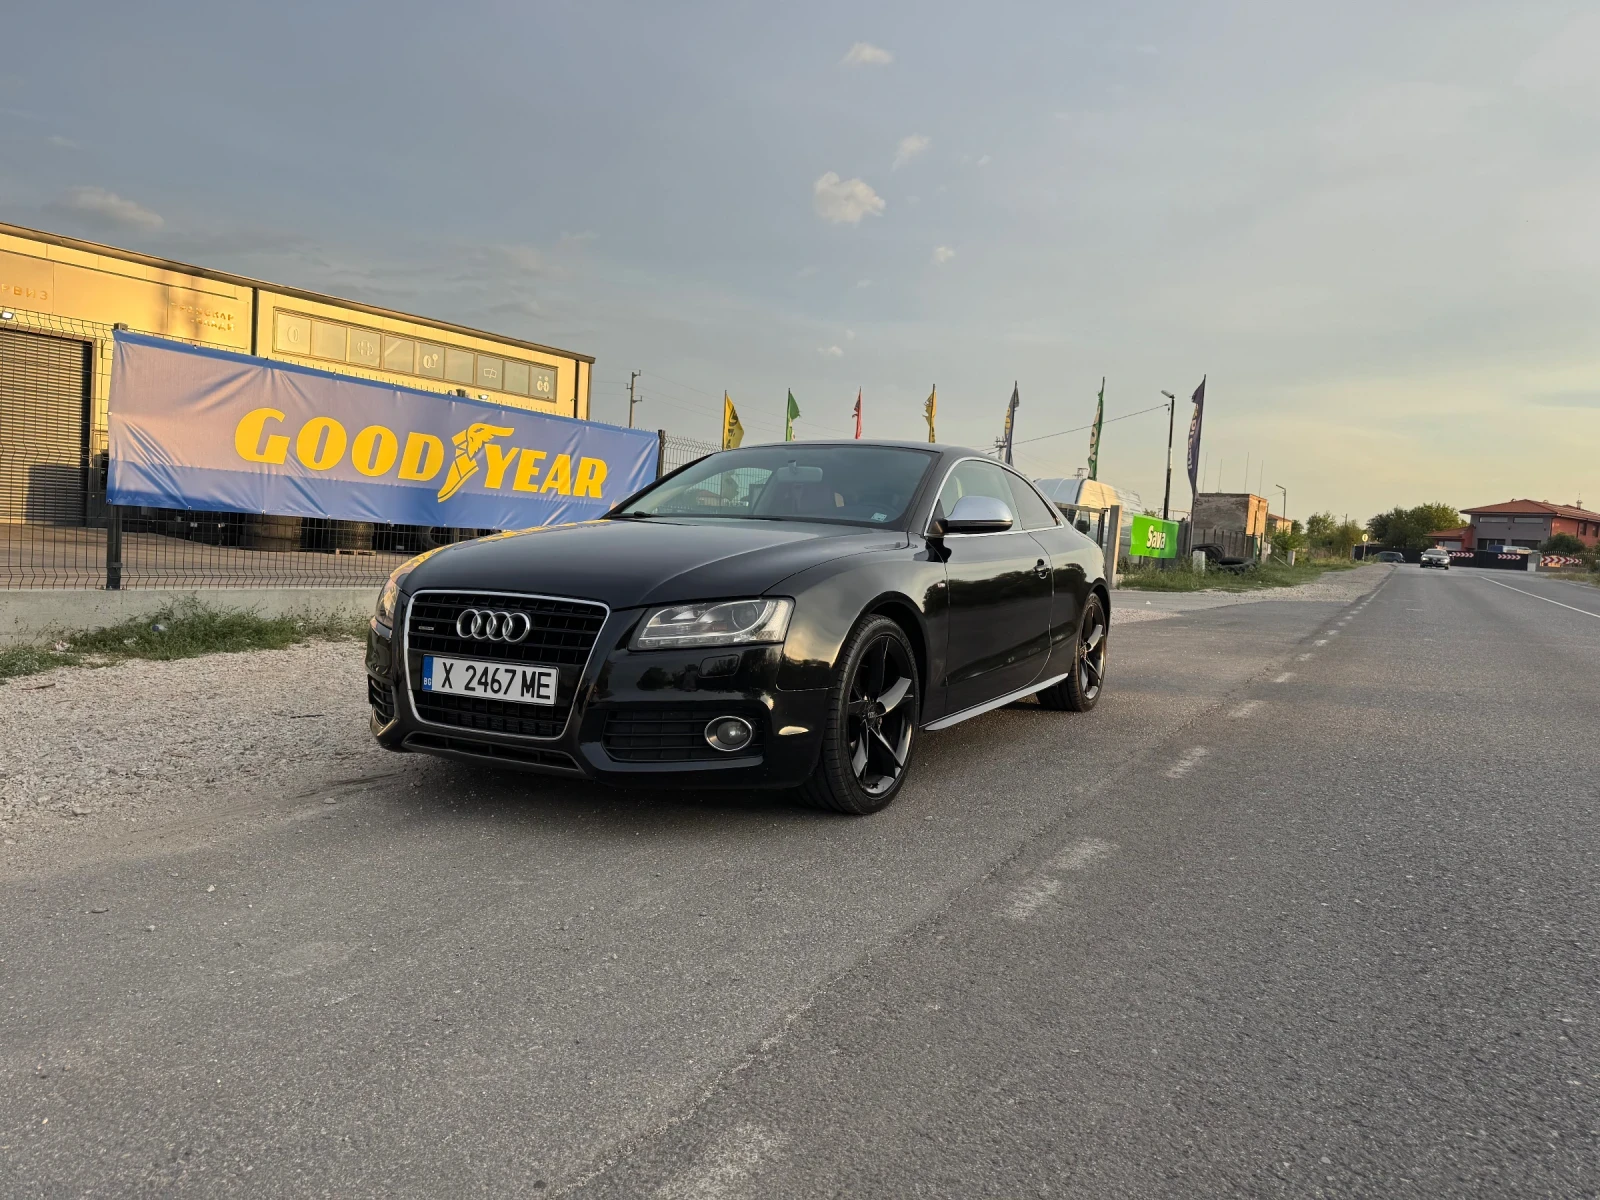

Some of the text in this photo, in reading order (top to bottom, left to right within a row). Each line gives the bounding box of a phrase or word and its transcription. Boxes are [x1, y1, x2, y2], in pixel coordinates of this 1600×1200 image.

[1146, 524, 1166, 549] Sava
[423, 677, 432, 686] BG
[441, 661, 552, 700] X 2467 ME
